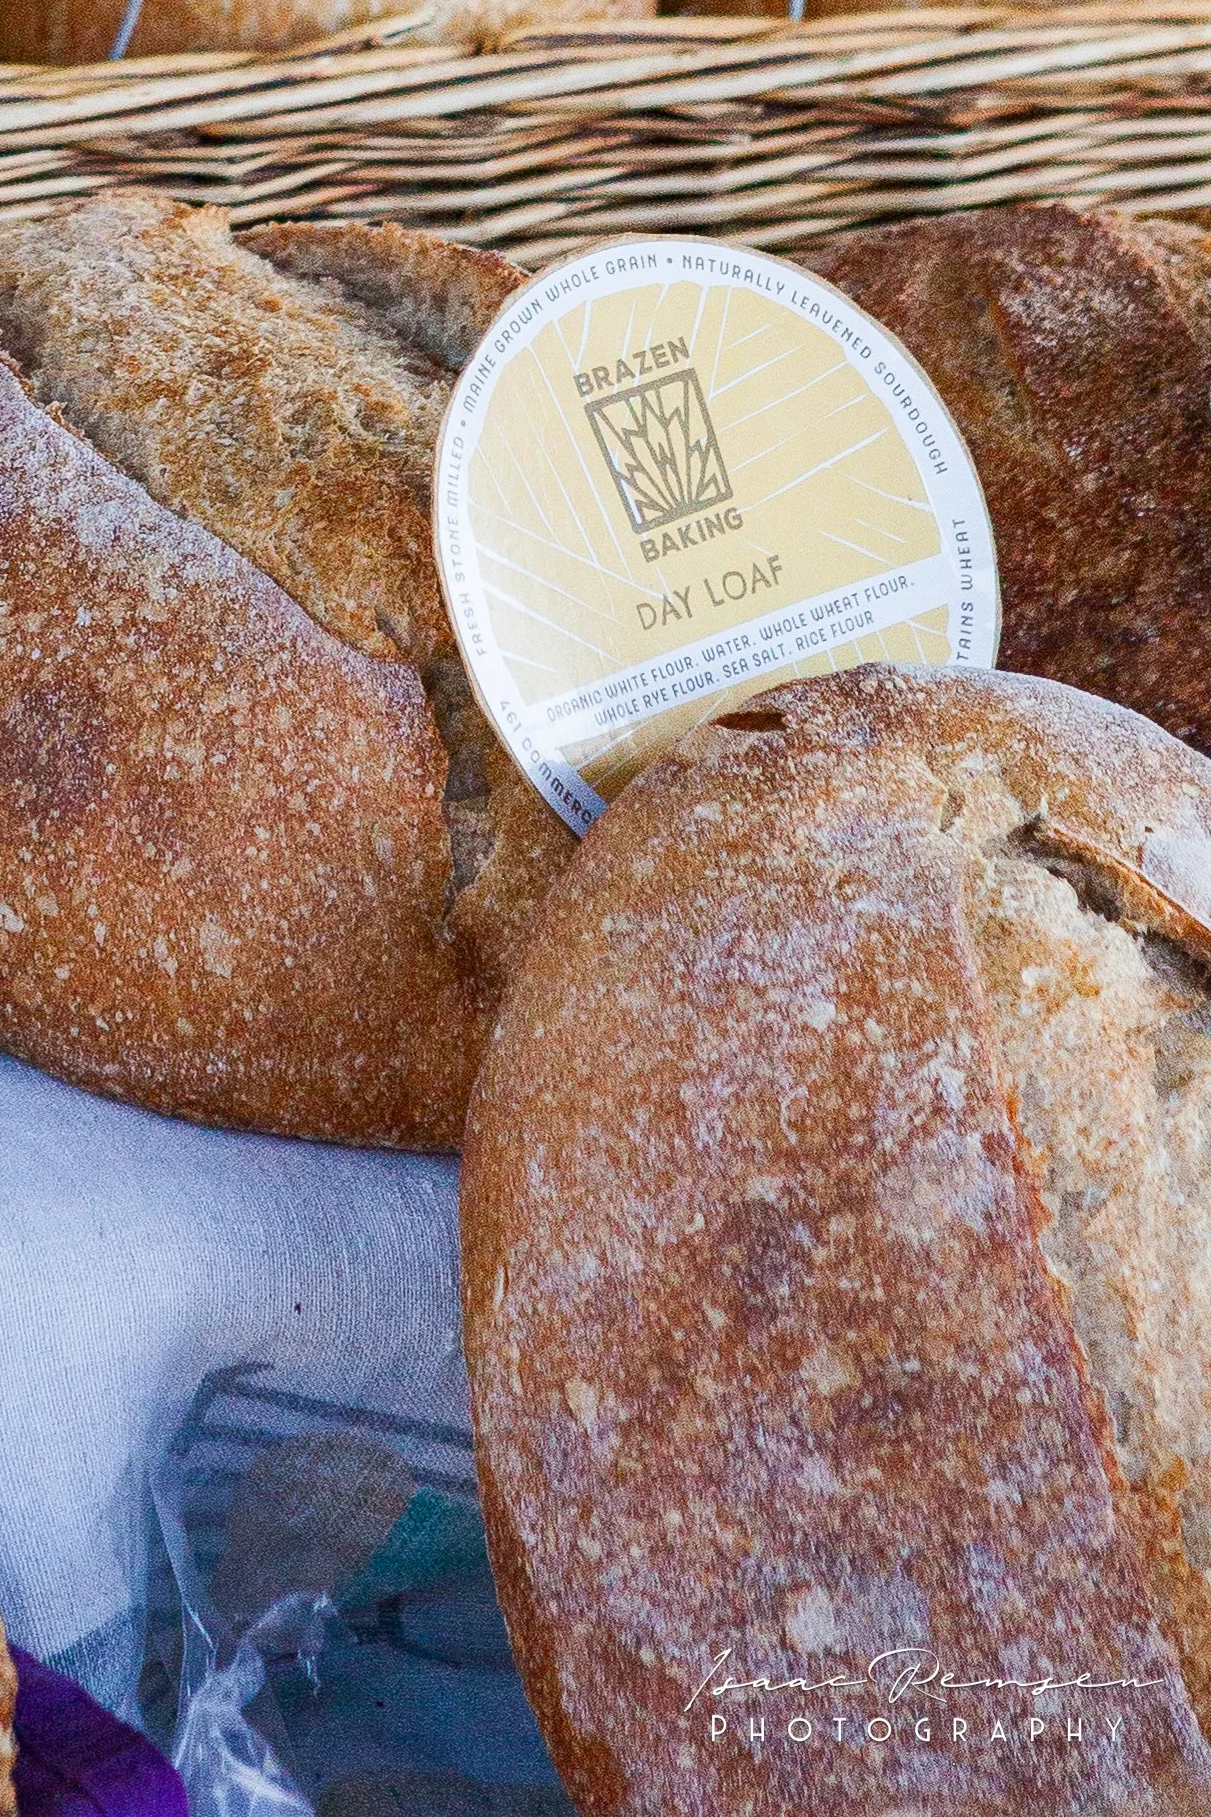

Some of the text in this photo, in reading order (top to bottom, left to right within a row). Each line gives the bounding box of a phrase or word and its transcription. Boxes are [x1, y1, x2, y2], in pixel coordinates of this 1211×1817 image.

[462, 252, 659, 414] MAINE GROWN WHOLE GRAIN
[572, 336, 691, 398] BRAZEN
[681, 253, 949, 476] NATURALLY LEAVENED SOURDOUGH
[446, 436, 488, 657] FRESH STONE MILLED
[635, 553, 785, 631] DAY LOAF
[638, 506, 745, 564] BAKING
[953, 518, 975, 661] TAINS WHEAT
[546, 690, 604, 723] ORGANIC
[604, 672, 649, 701] WHITE
[758, 612, 809, 642] WHOLE
[809, 592, 862, 622] WHEAT
[594, 699, 641, 727] WHOLE
[644, 687, 669, 708] RYE
[722, 657, 751, 679] SEA
[794, 628, 829, 652] RICE
[831, 610, 876, 638] FLOUR
[499, 700, 594, 826] 461 COMMERC
